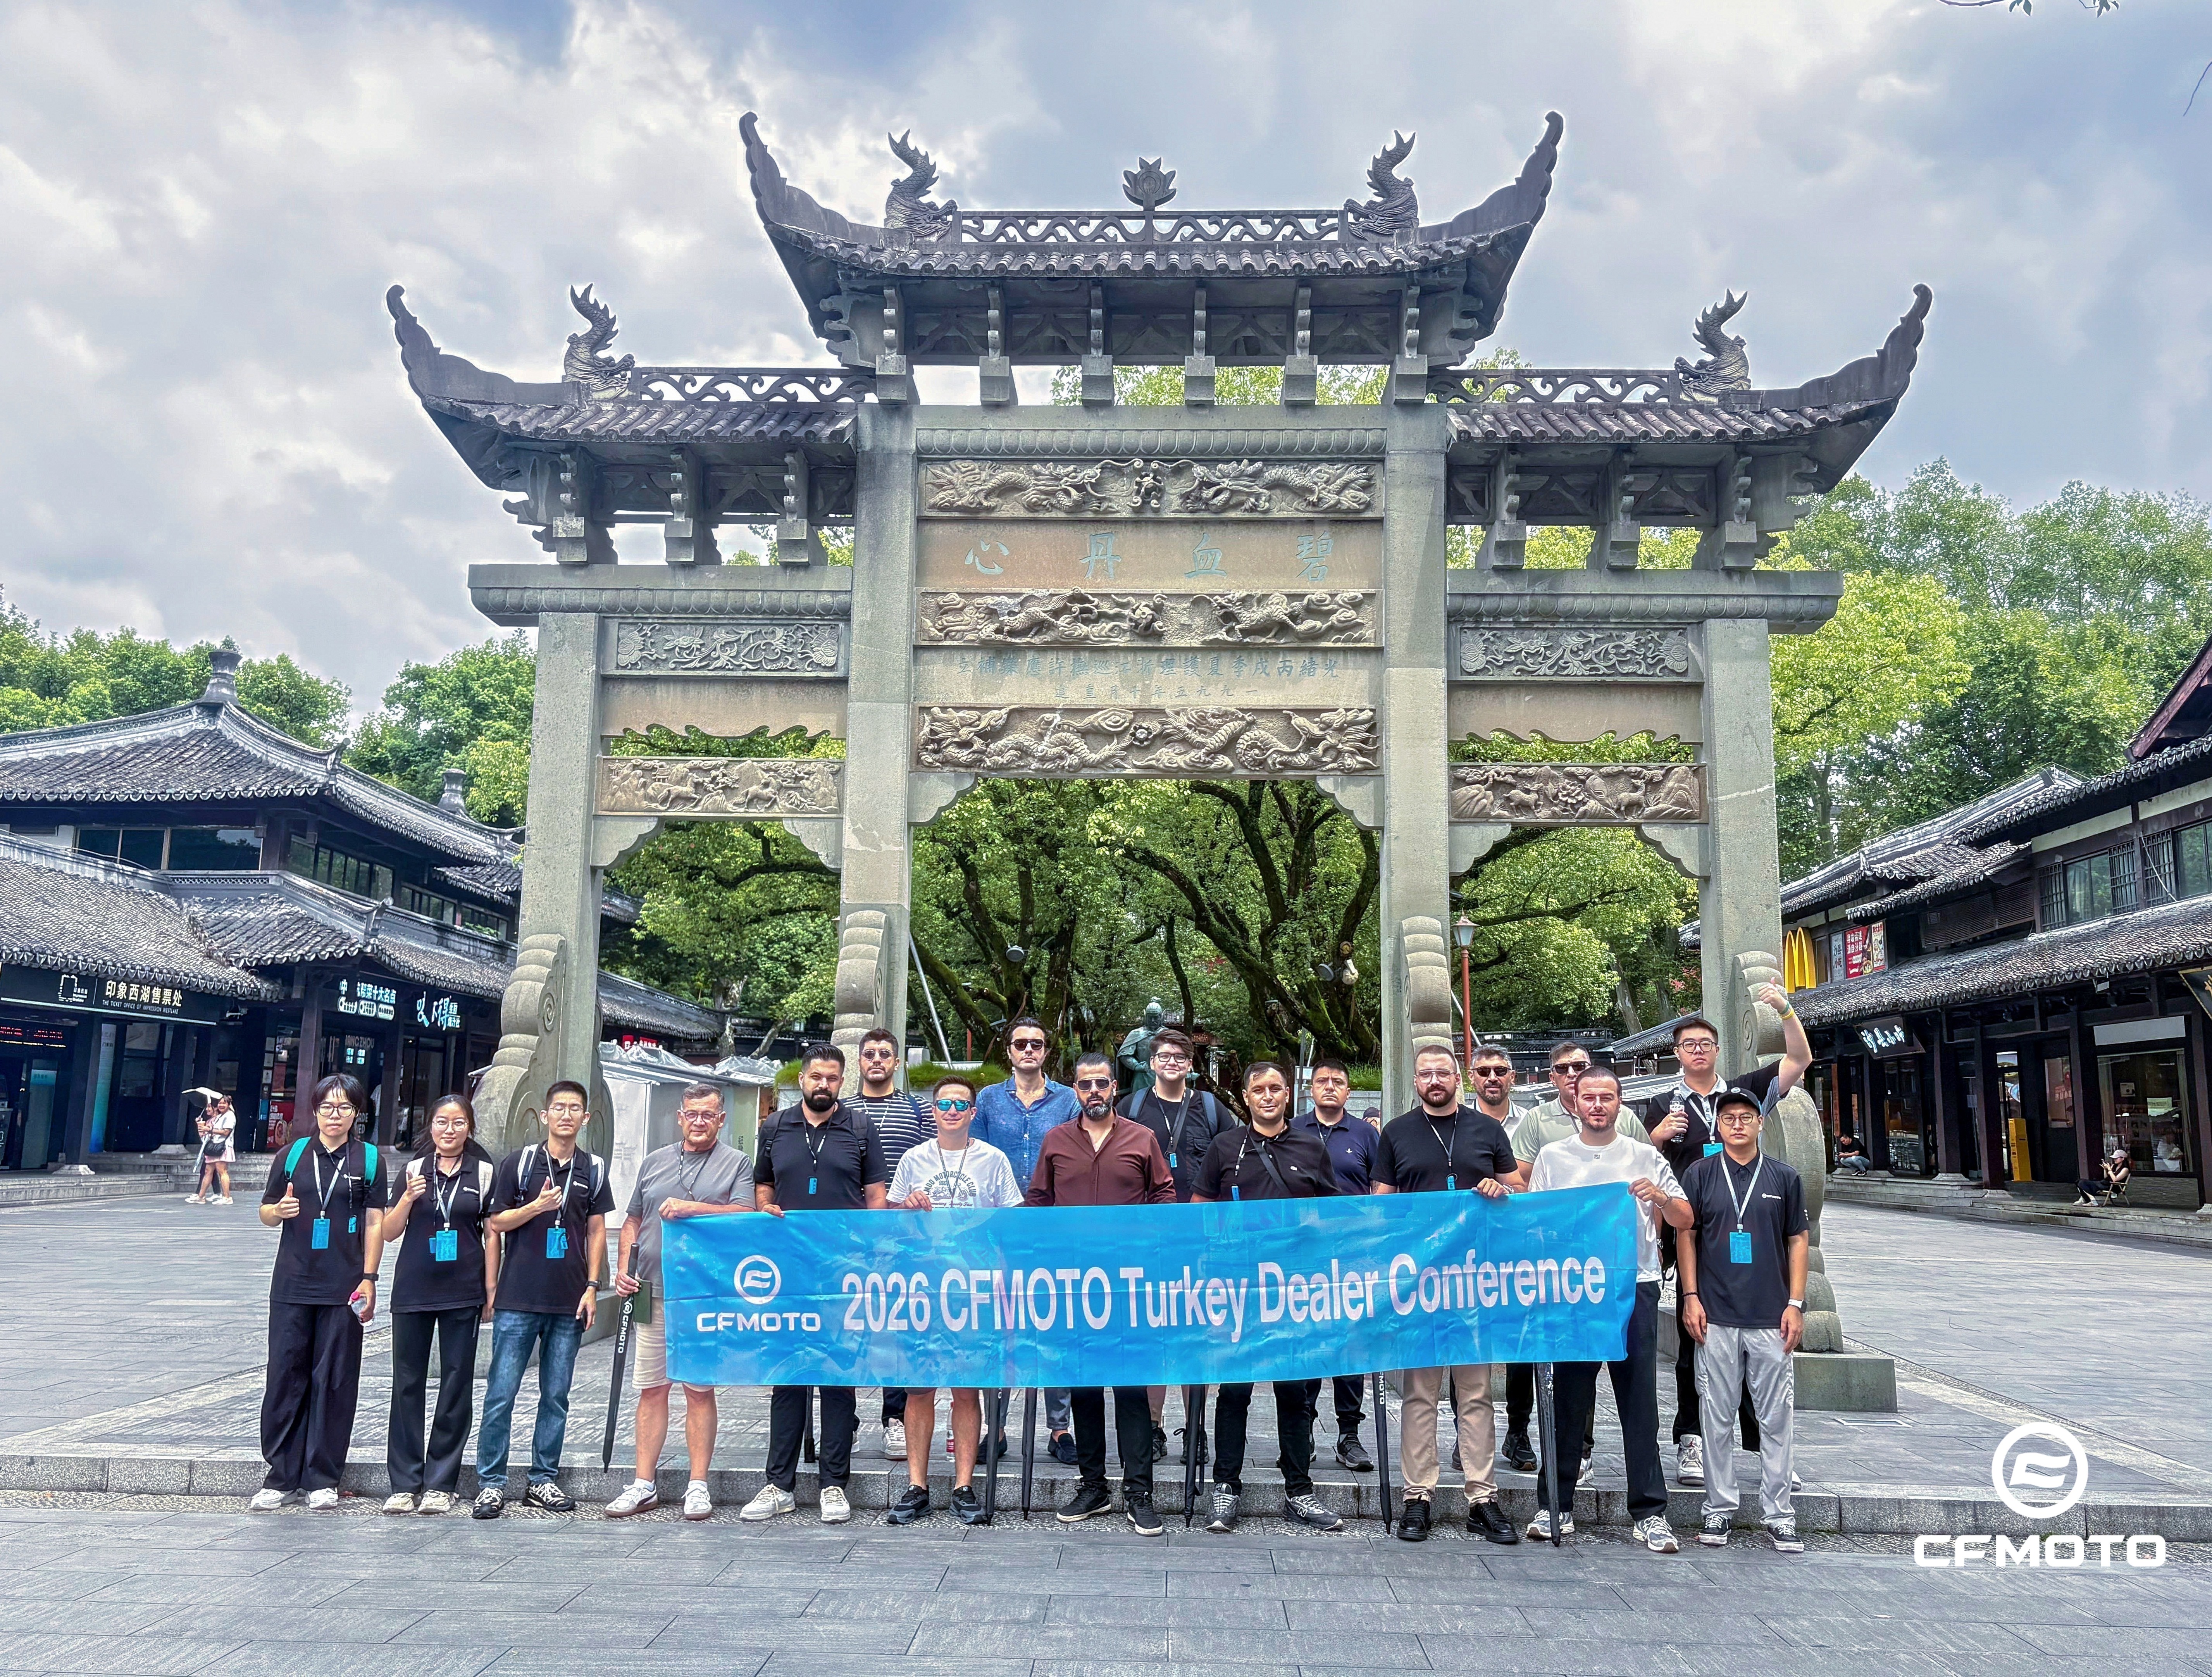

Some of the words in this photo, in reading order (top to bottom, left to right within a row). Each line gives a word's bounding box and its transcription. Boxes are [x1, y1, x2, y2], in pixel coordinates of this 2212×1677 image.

[105, 979, 183, 1007] 印象西湖售票处
[966, 1181, 977, 1197] CLUB
[842, 1271, 930, 1332] 2026
[939, 1266, 1112, 1332] CFMOTO
[1119, 1265, 1249, 1343] Turkey
[1258, 1258, 1379, 1323] Dealer
[1389, 1249, 1606, 1316] Conference
[618, 1315, 629, 1353] CFMOTO
[696, 1312, 821, 1332] CFMOTO
